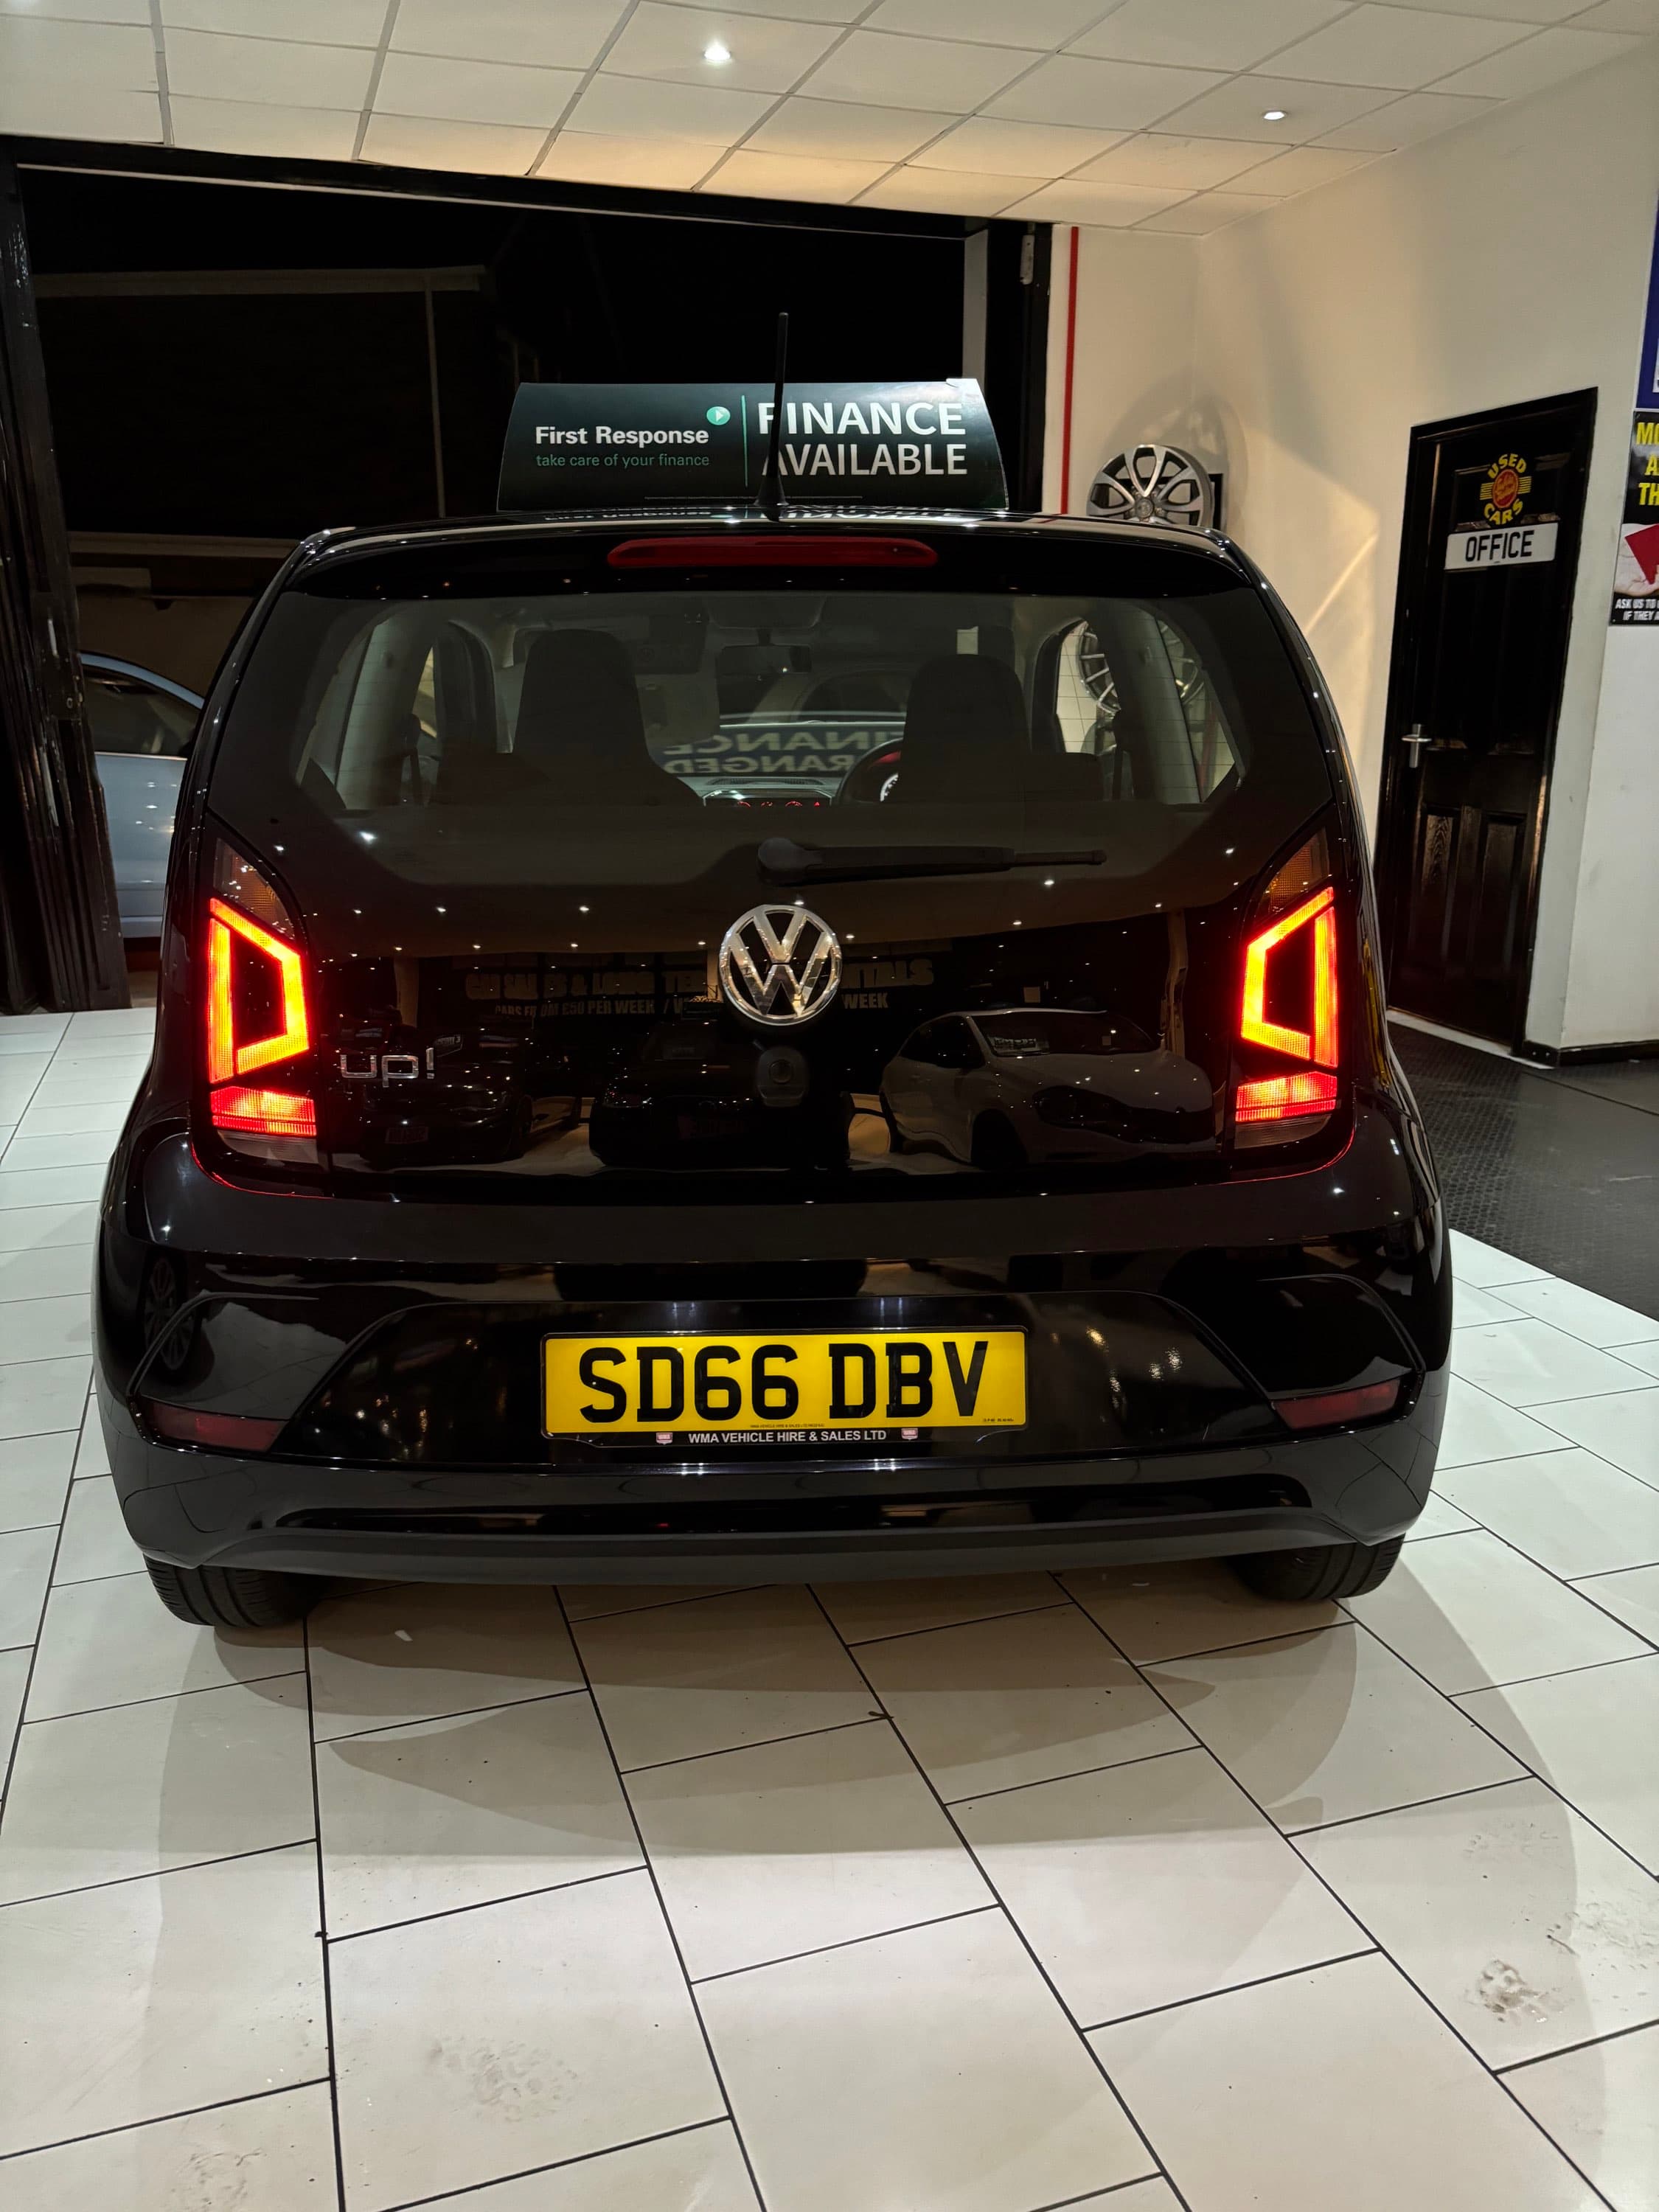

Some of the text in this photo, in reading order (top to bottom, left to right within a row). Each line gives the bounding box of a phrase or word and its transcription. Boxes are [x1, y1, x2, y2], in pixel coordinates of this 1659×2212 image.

[758, 402, 966, 435] FINANCE
[535, 425, 709, 448] First Response
[536, 454, 709, 469] take care of your finance
[1487, 453, 1527, 479] USED
[1484, 498, 1523, 525] CARS
[1465, 529, 1534, 562] OFFICE
[841, 992, 889, 1009] WEEK
[578, 1340, 990, 1424] SD66 DBV
[688, 1430, 887, 1444] WMA VEHICLE HIRE & SALES LTD
